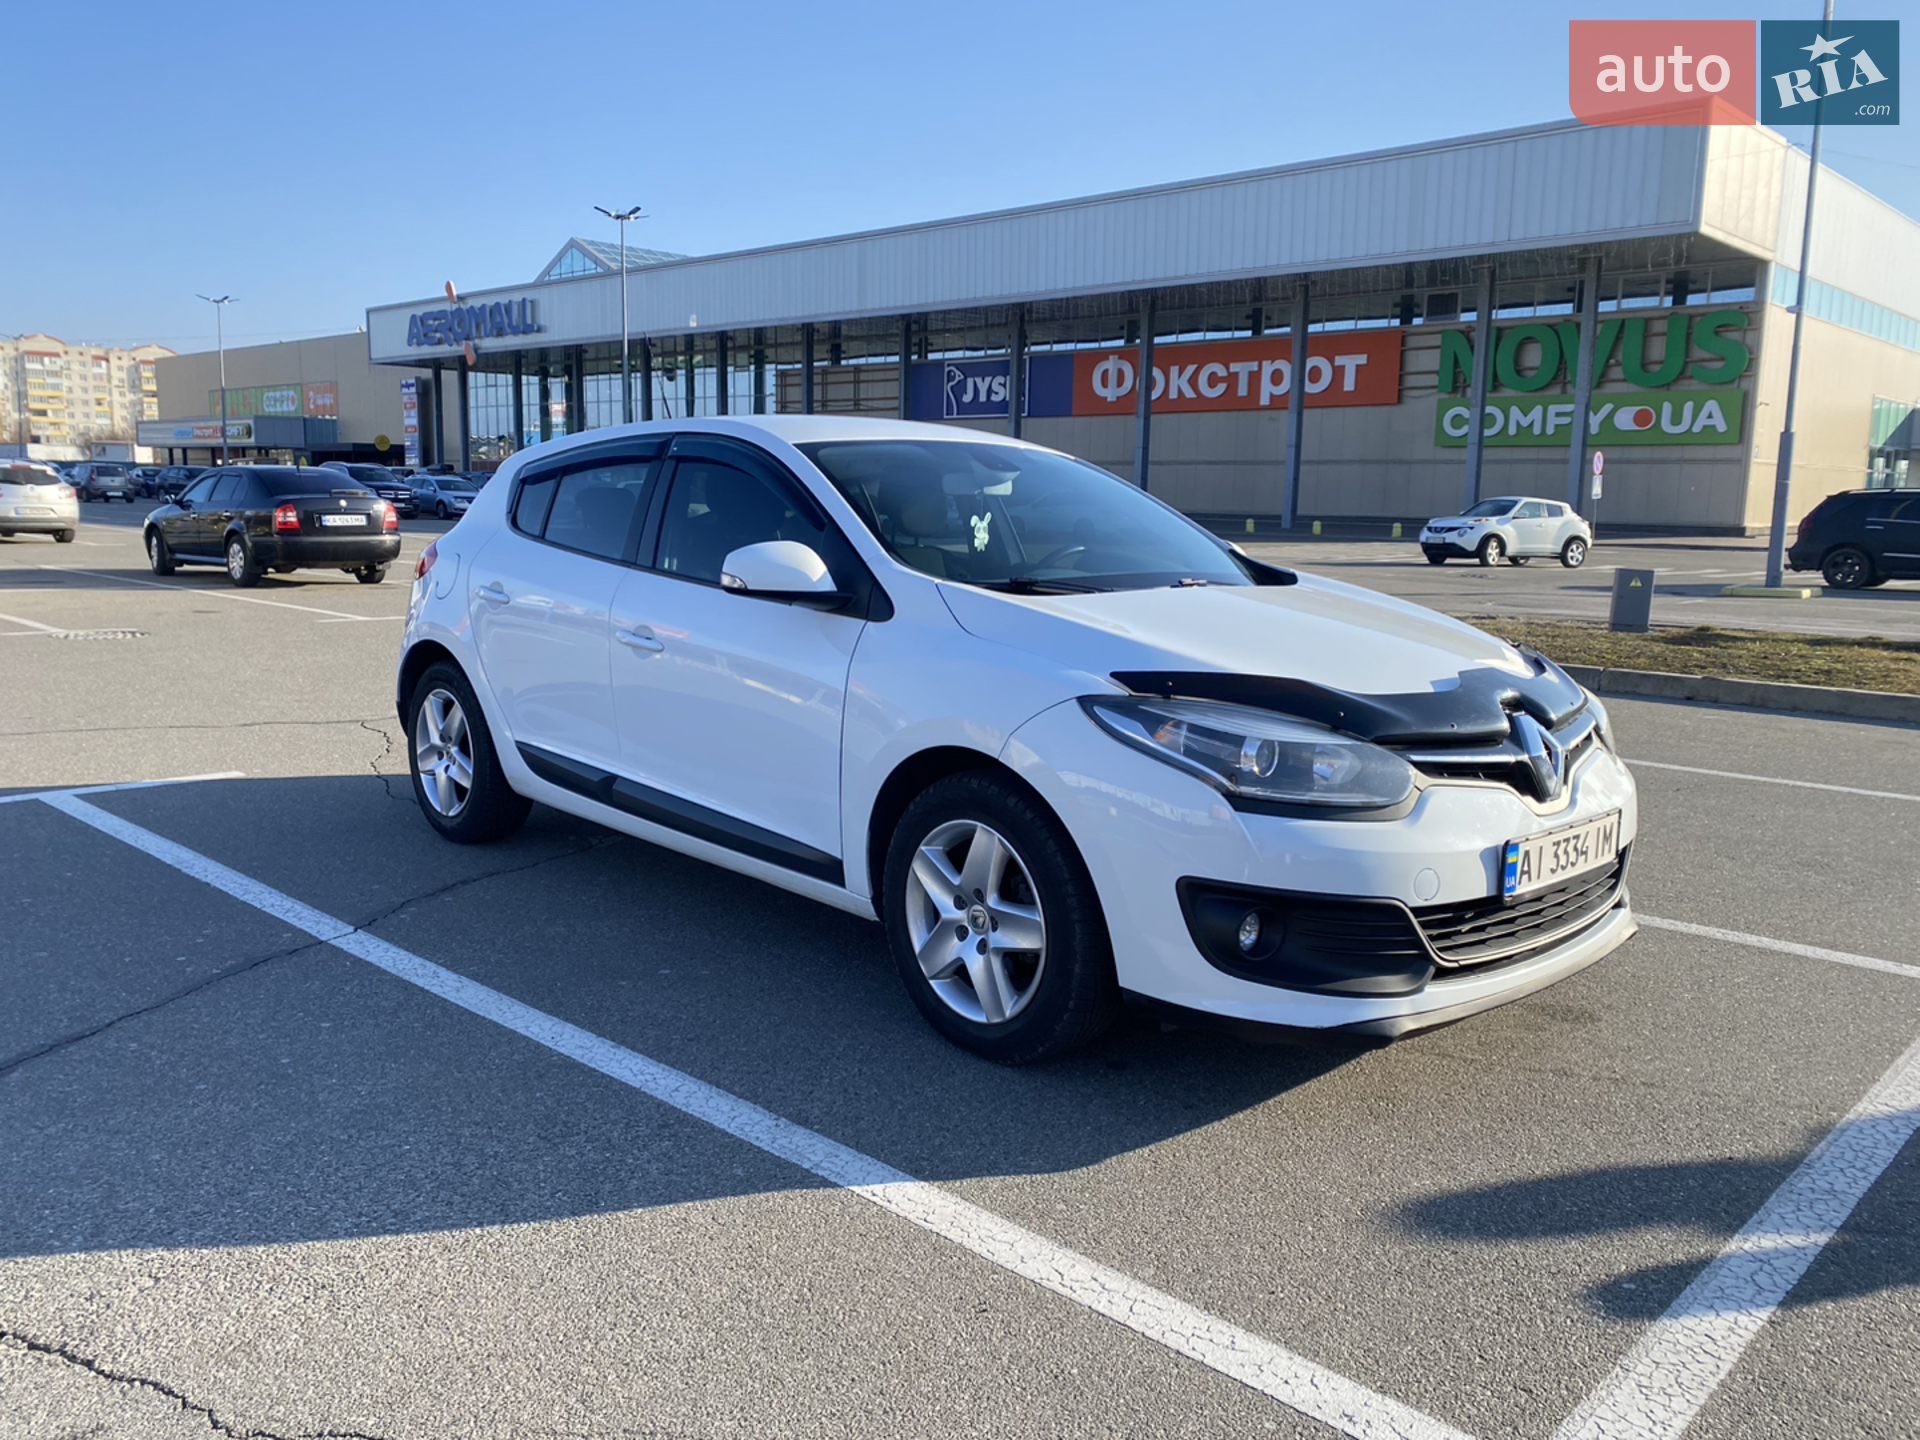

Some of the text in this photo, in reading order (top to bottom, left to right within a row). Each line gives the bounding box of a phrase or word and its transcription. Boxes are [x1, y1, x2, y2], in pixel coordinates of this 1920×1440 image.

[407, 297, 536, 347] AEROMALL
[1437, 309, 1750, 393] NOVUS
[1091, 354, 1368, 405] Фокстрот
[1660, 399, 1728, 435] UA
[1518, 822, 1614, 886] AI 3334 IM
[1506, 875, 1516, 888] UA
